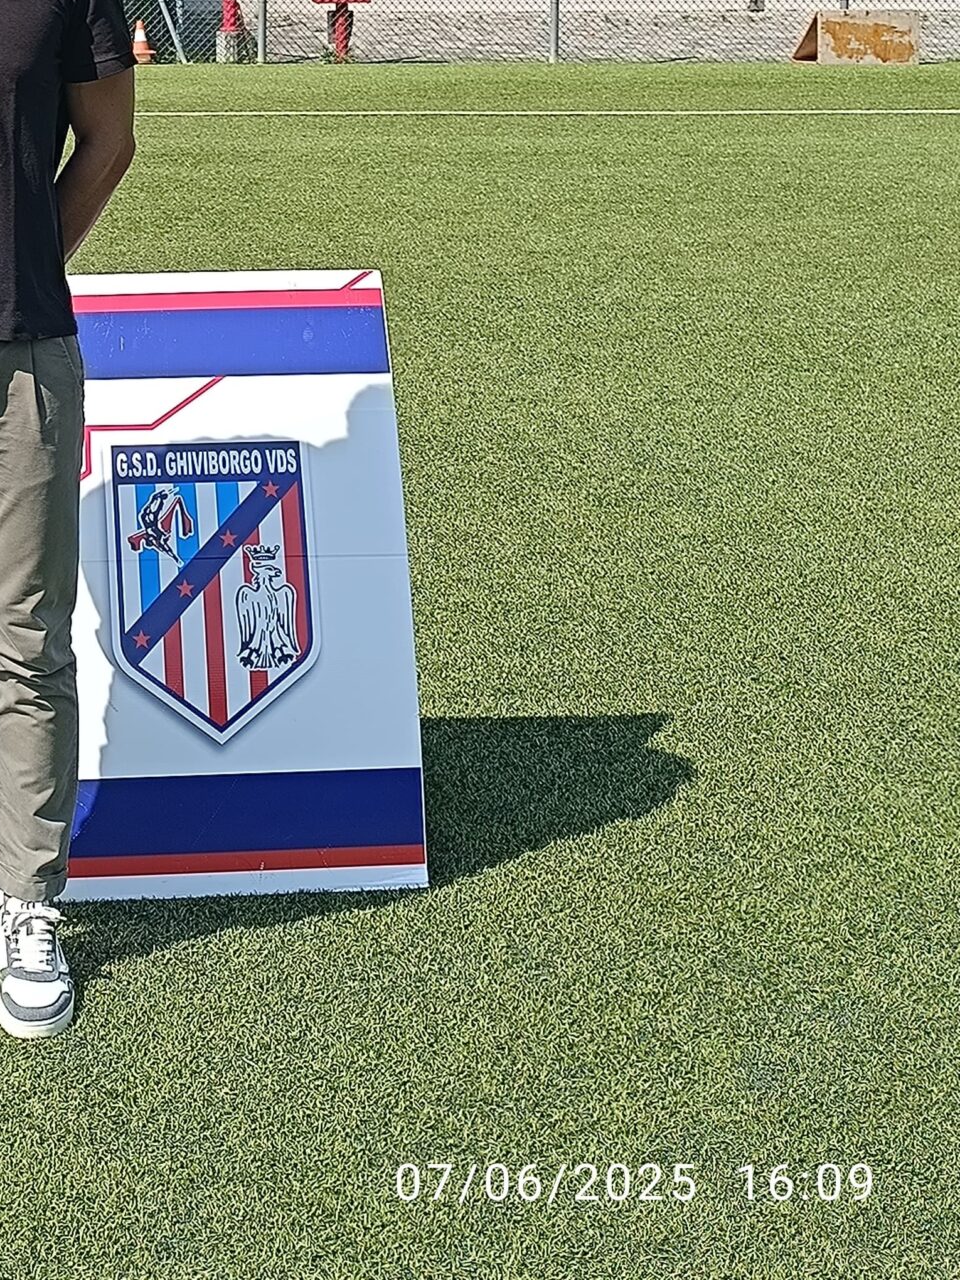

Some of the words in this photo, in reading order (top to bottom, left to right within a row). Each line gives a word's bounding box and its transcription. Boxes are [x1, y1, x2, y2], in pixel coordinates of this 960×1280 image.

[116, 452, 162, 478] G.S.D.
[165, 449, 262, 475] GHIVIBORGO
[265, 448, 297, 473] VDS
